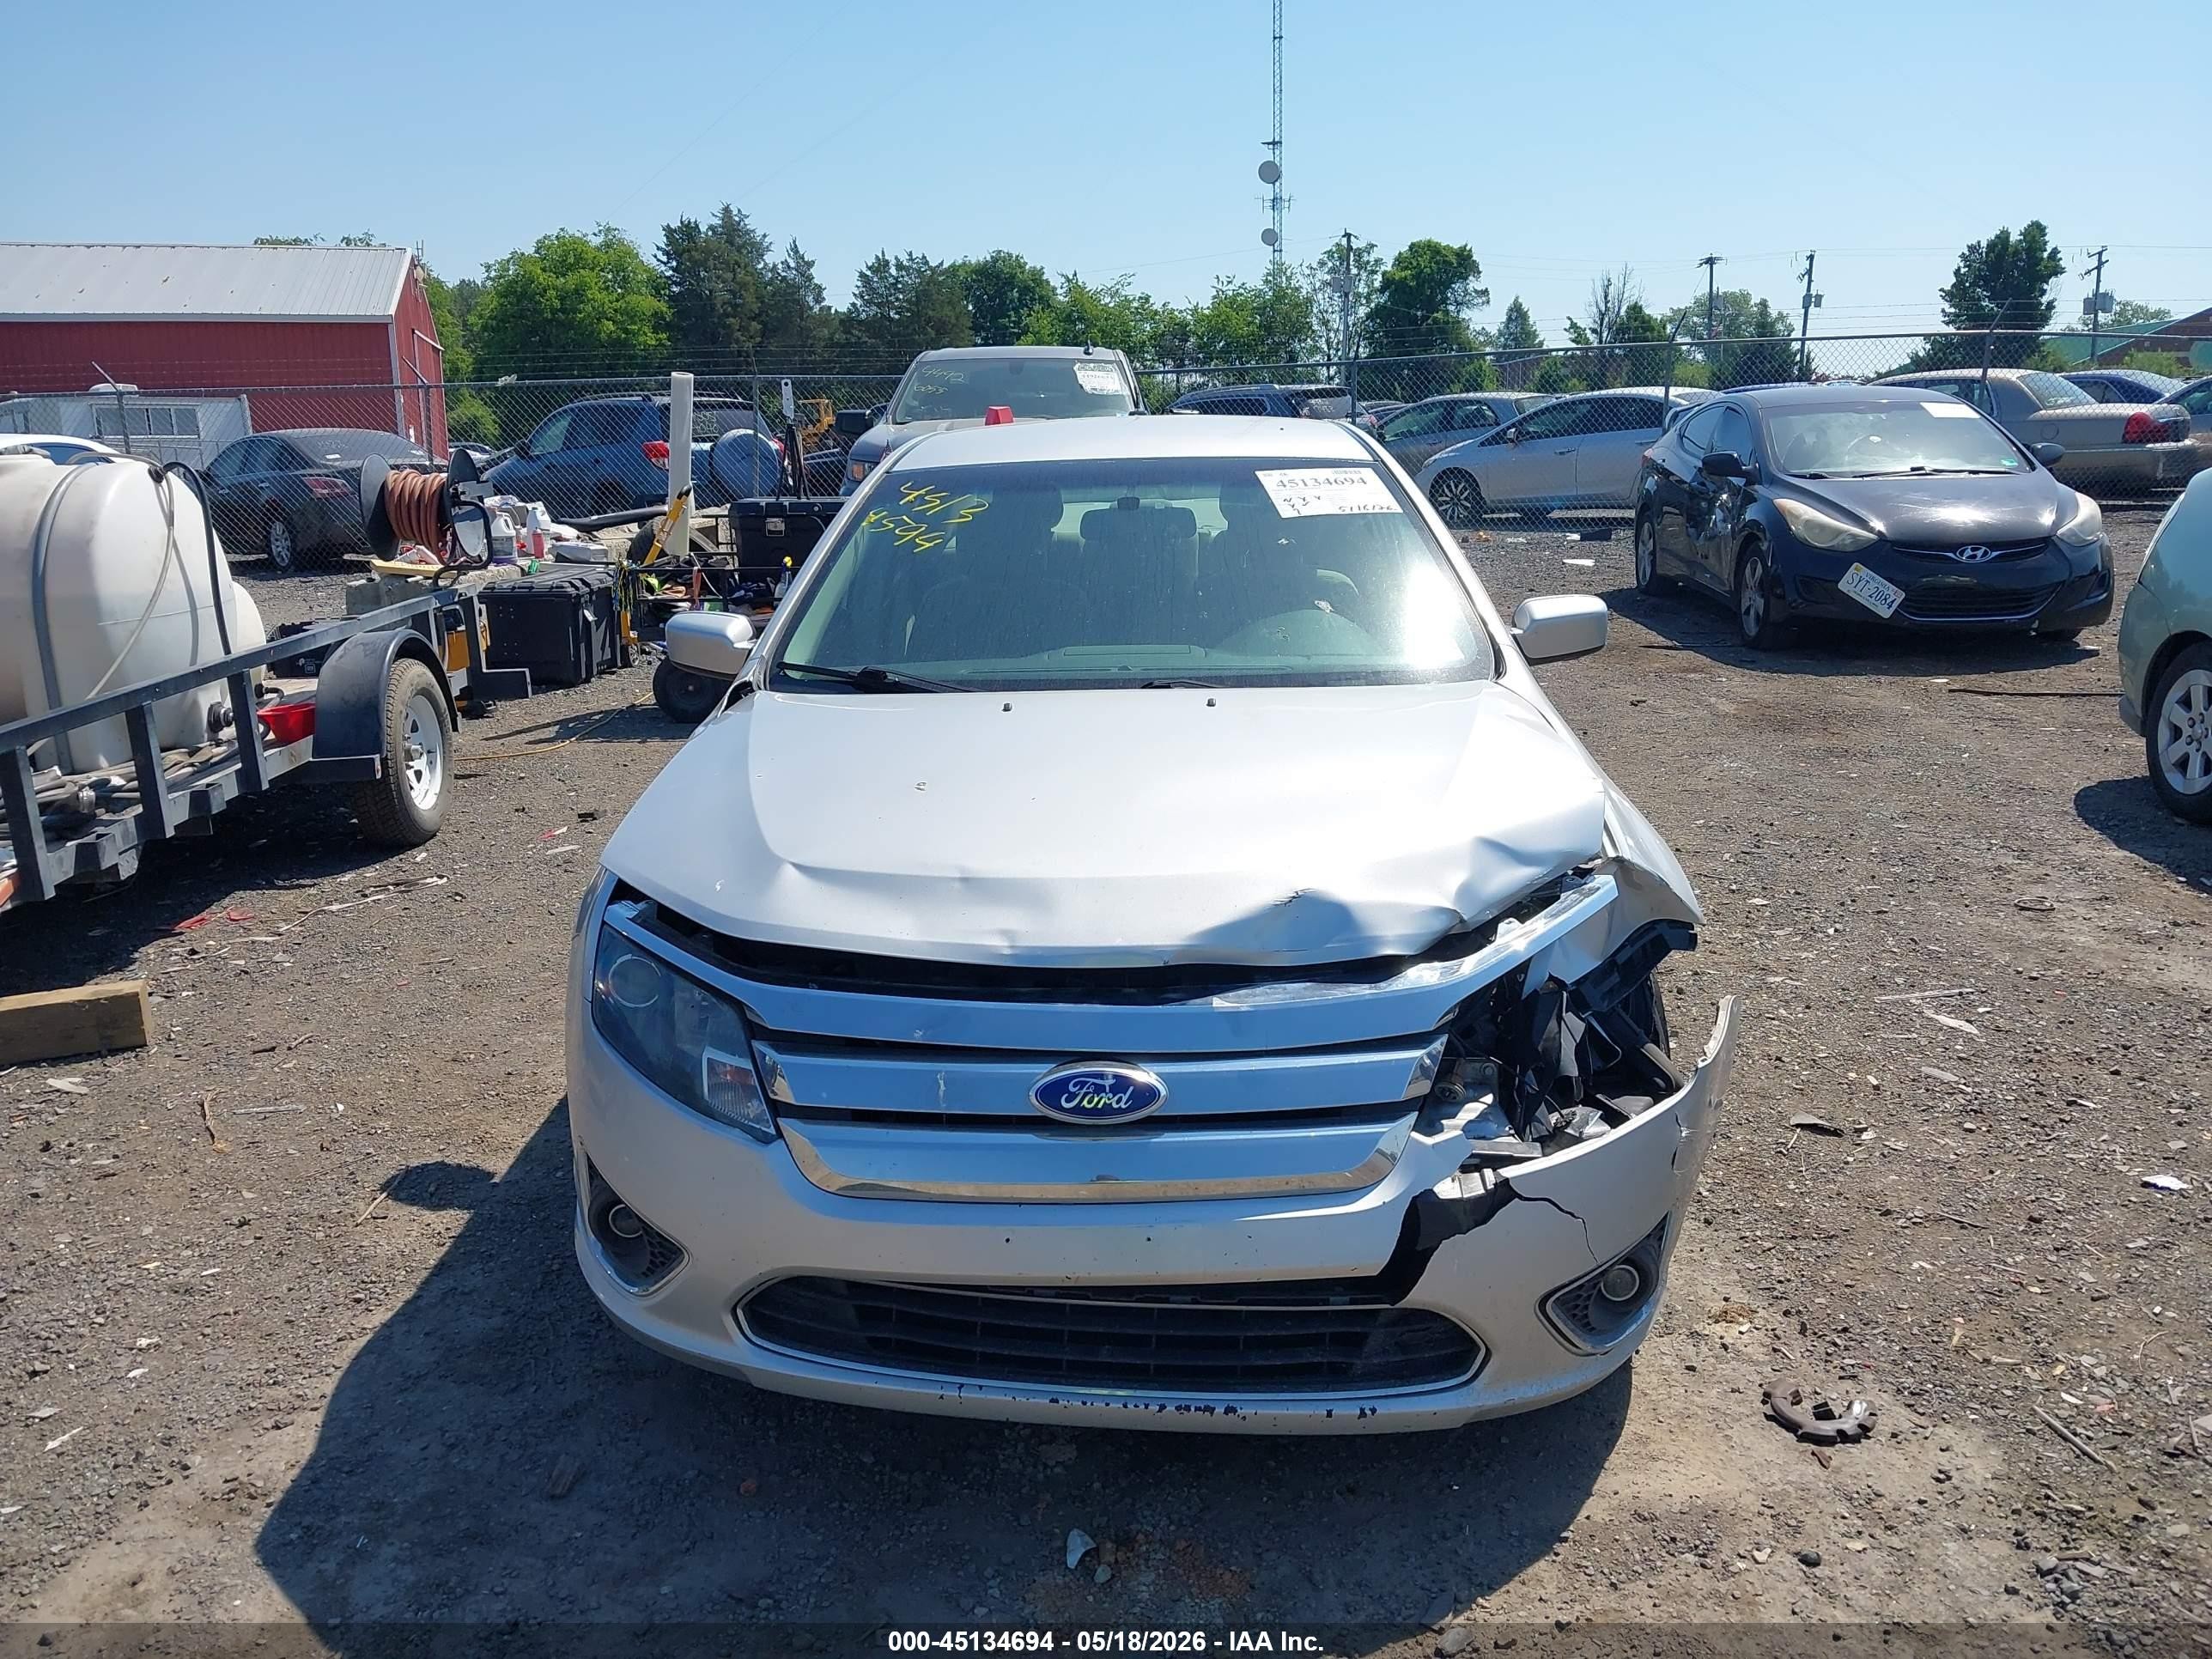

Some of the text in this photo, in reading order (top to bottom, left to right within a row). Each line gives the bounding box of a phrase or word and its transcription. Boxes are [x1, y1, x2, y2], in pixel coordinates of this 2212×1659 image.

[921, 365, 968, 384] 4492
[1276, 477, 1368, 489] 45134694
[899, 481, 989, 524] 4513
[1846, 572, 1897, 610] SYT-2084
[1865, 571, 1890, 592] VIRGINIA
[1060, 1077, 1134, 1109] Ford
